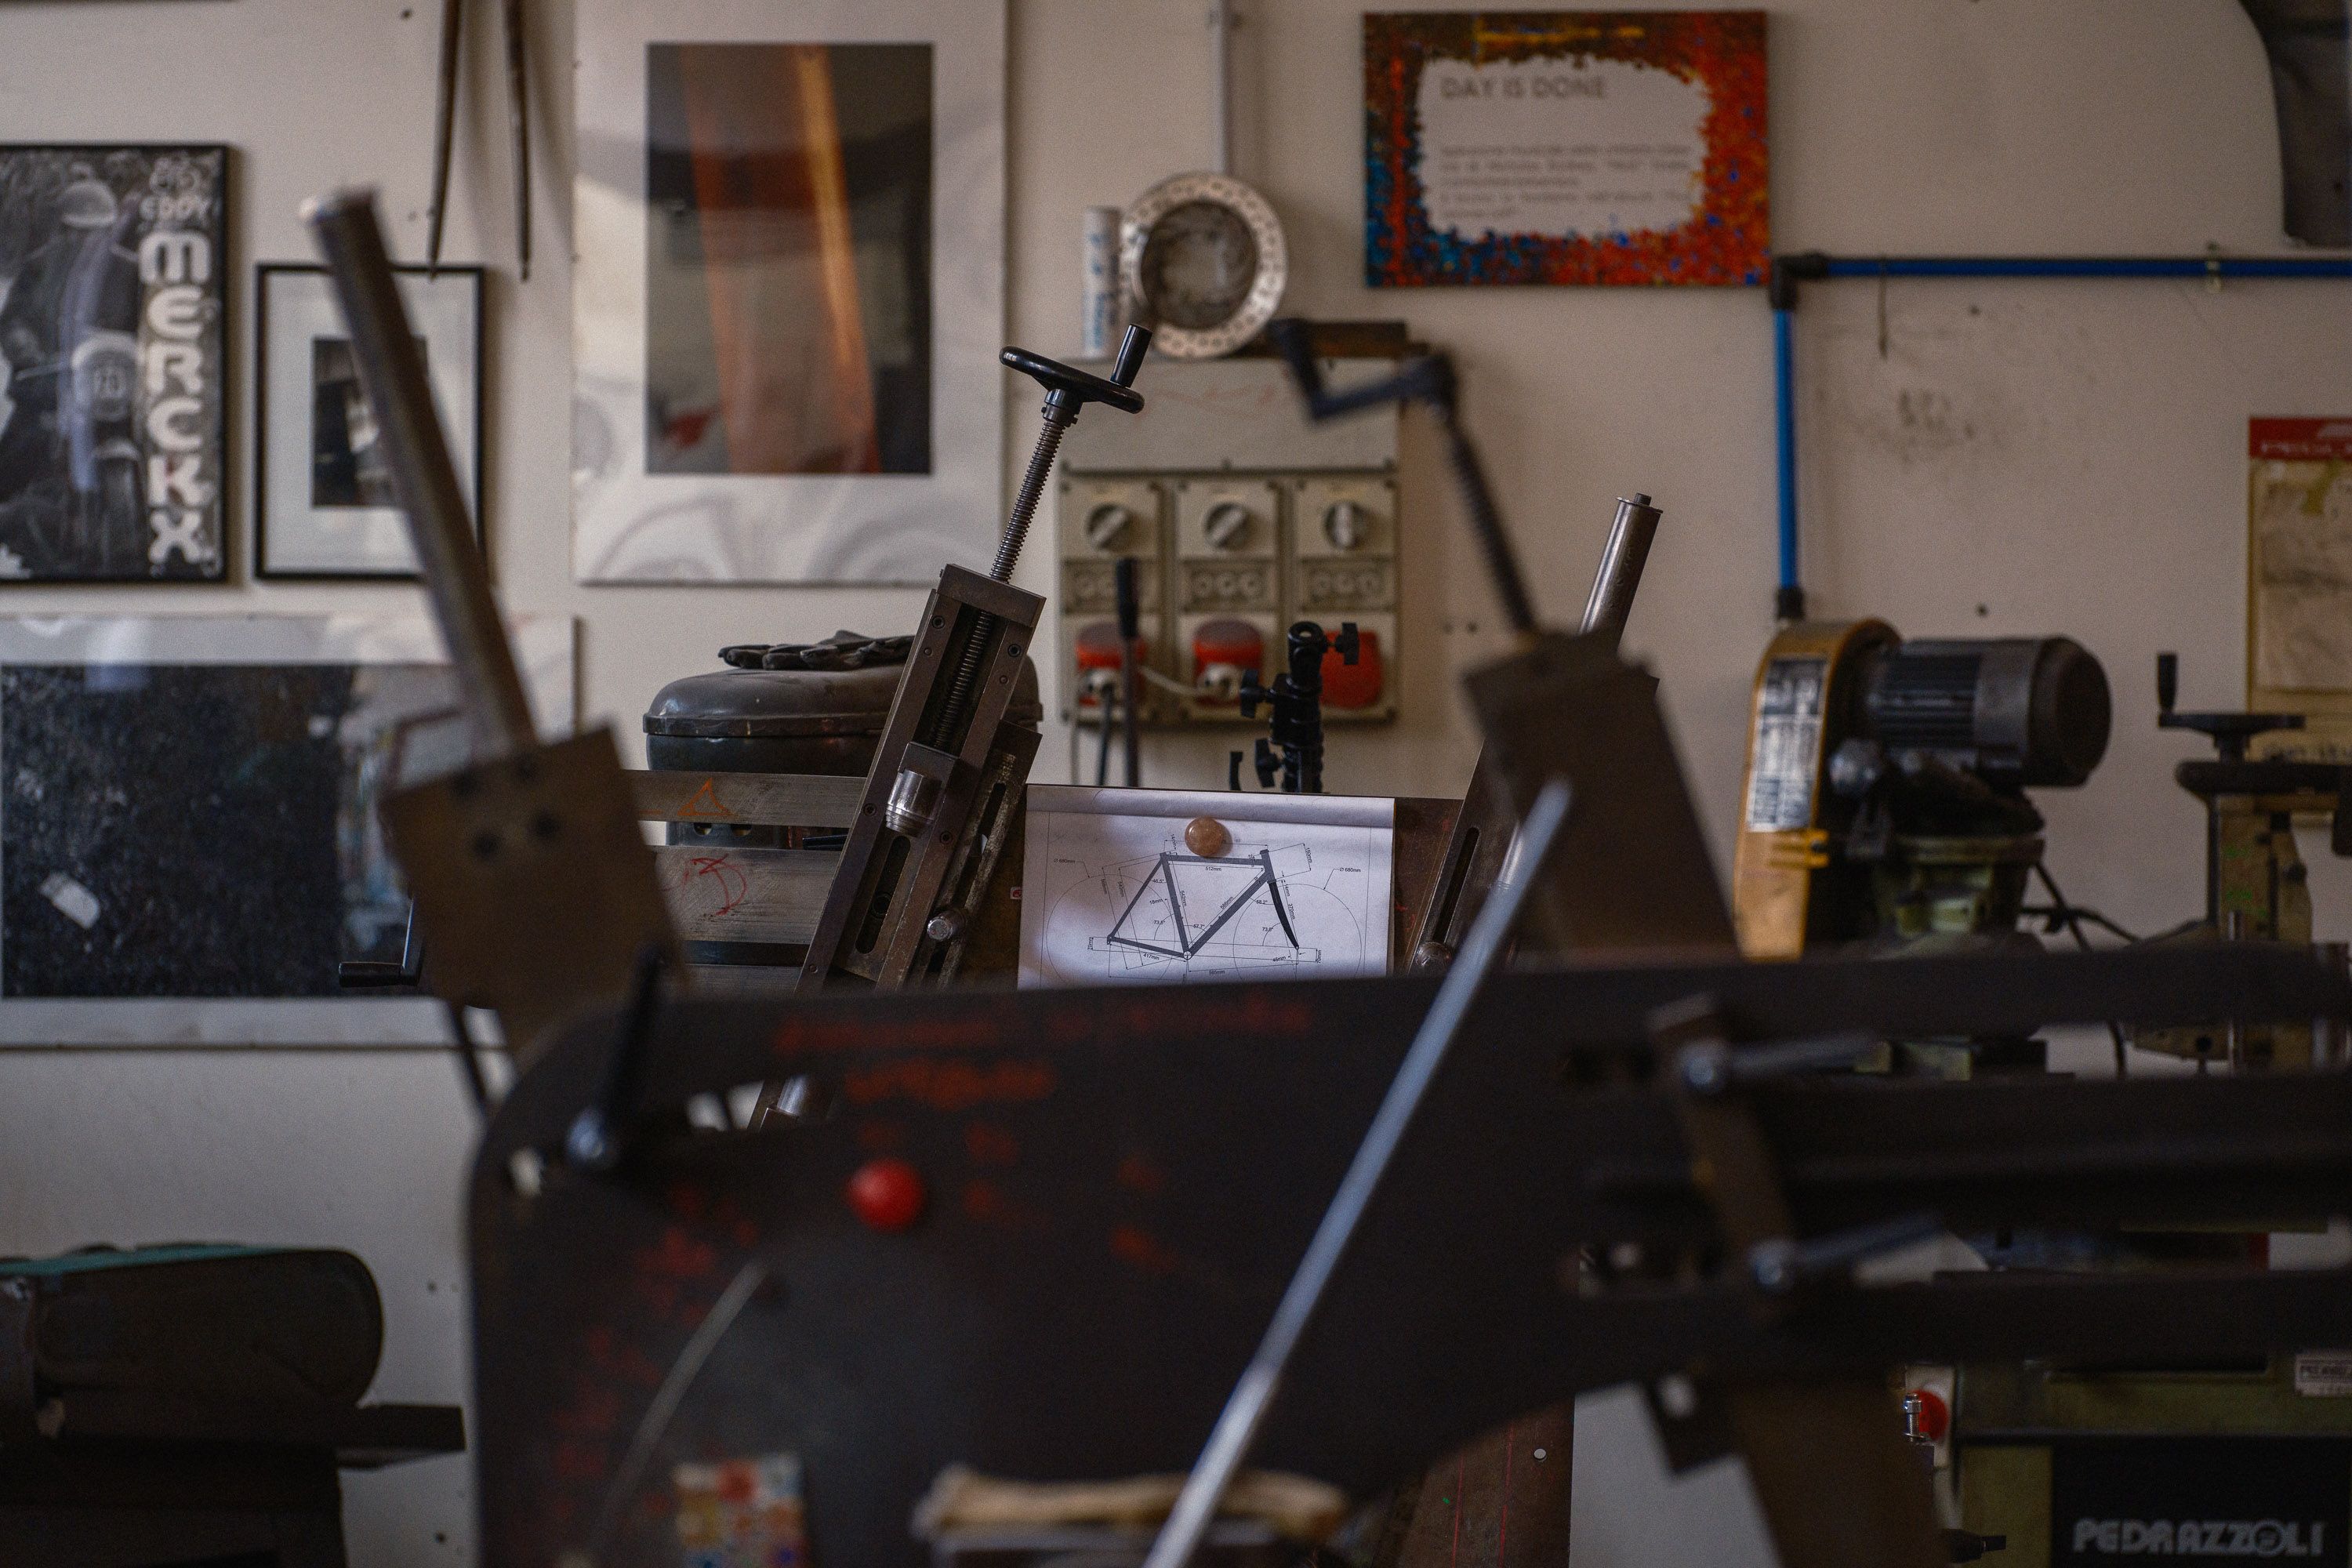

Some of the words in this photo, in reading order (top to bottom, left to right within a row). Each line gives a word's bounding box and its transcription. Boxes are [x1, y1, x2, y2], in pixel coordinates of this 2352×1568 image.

[1440, 76, 1494, 100] DAY
[1503, 76, 1522, 100] IS
[1531, 76, 1605, 100] DONE
[2073, 1518, 2326, 1557] PEDRAZZOLI
